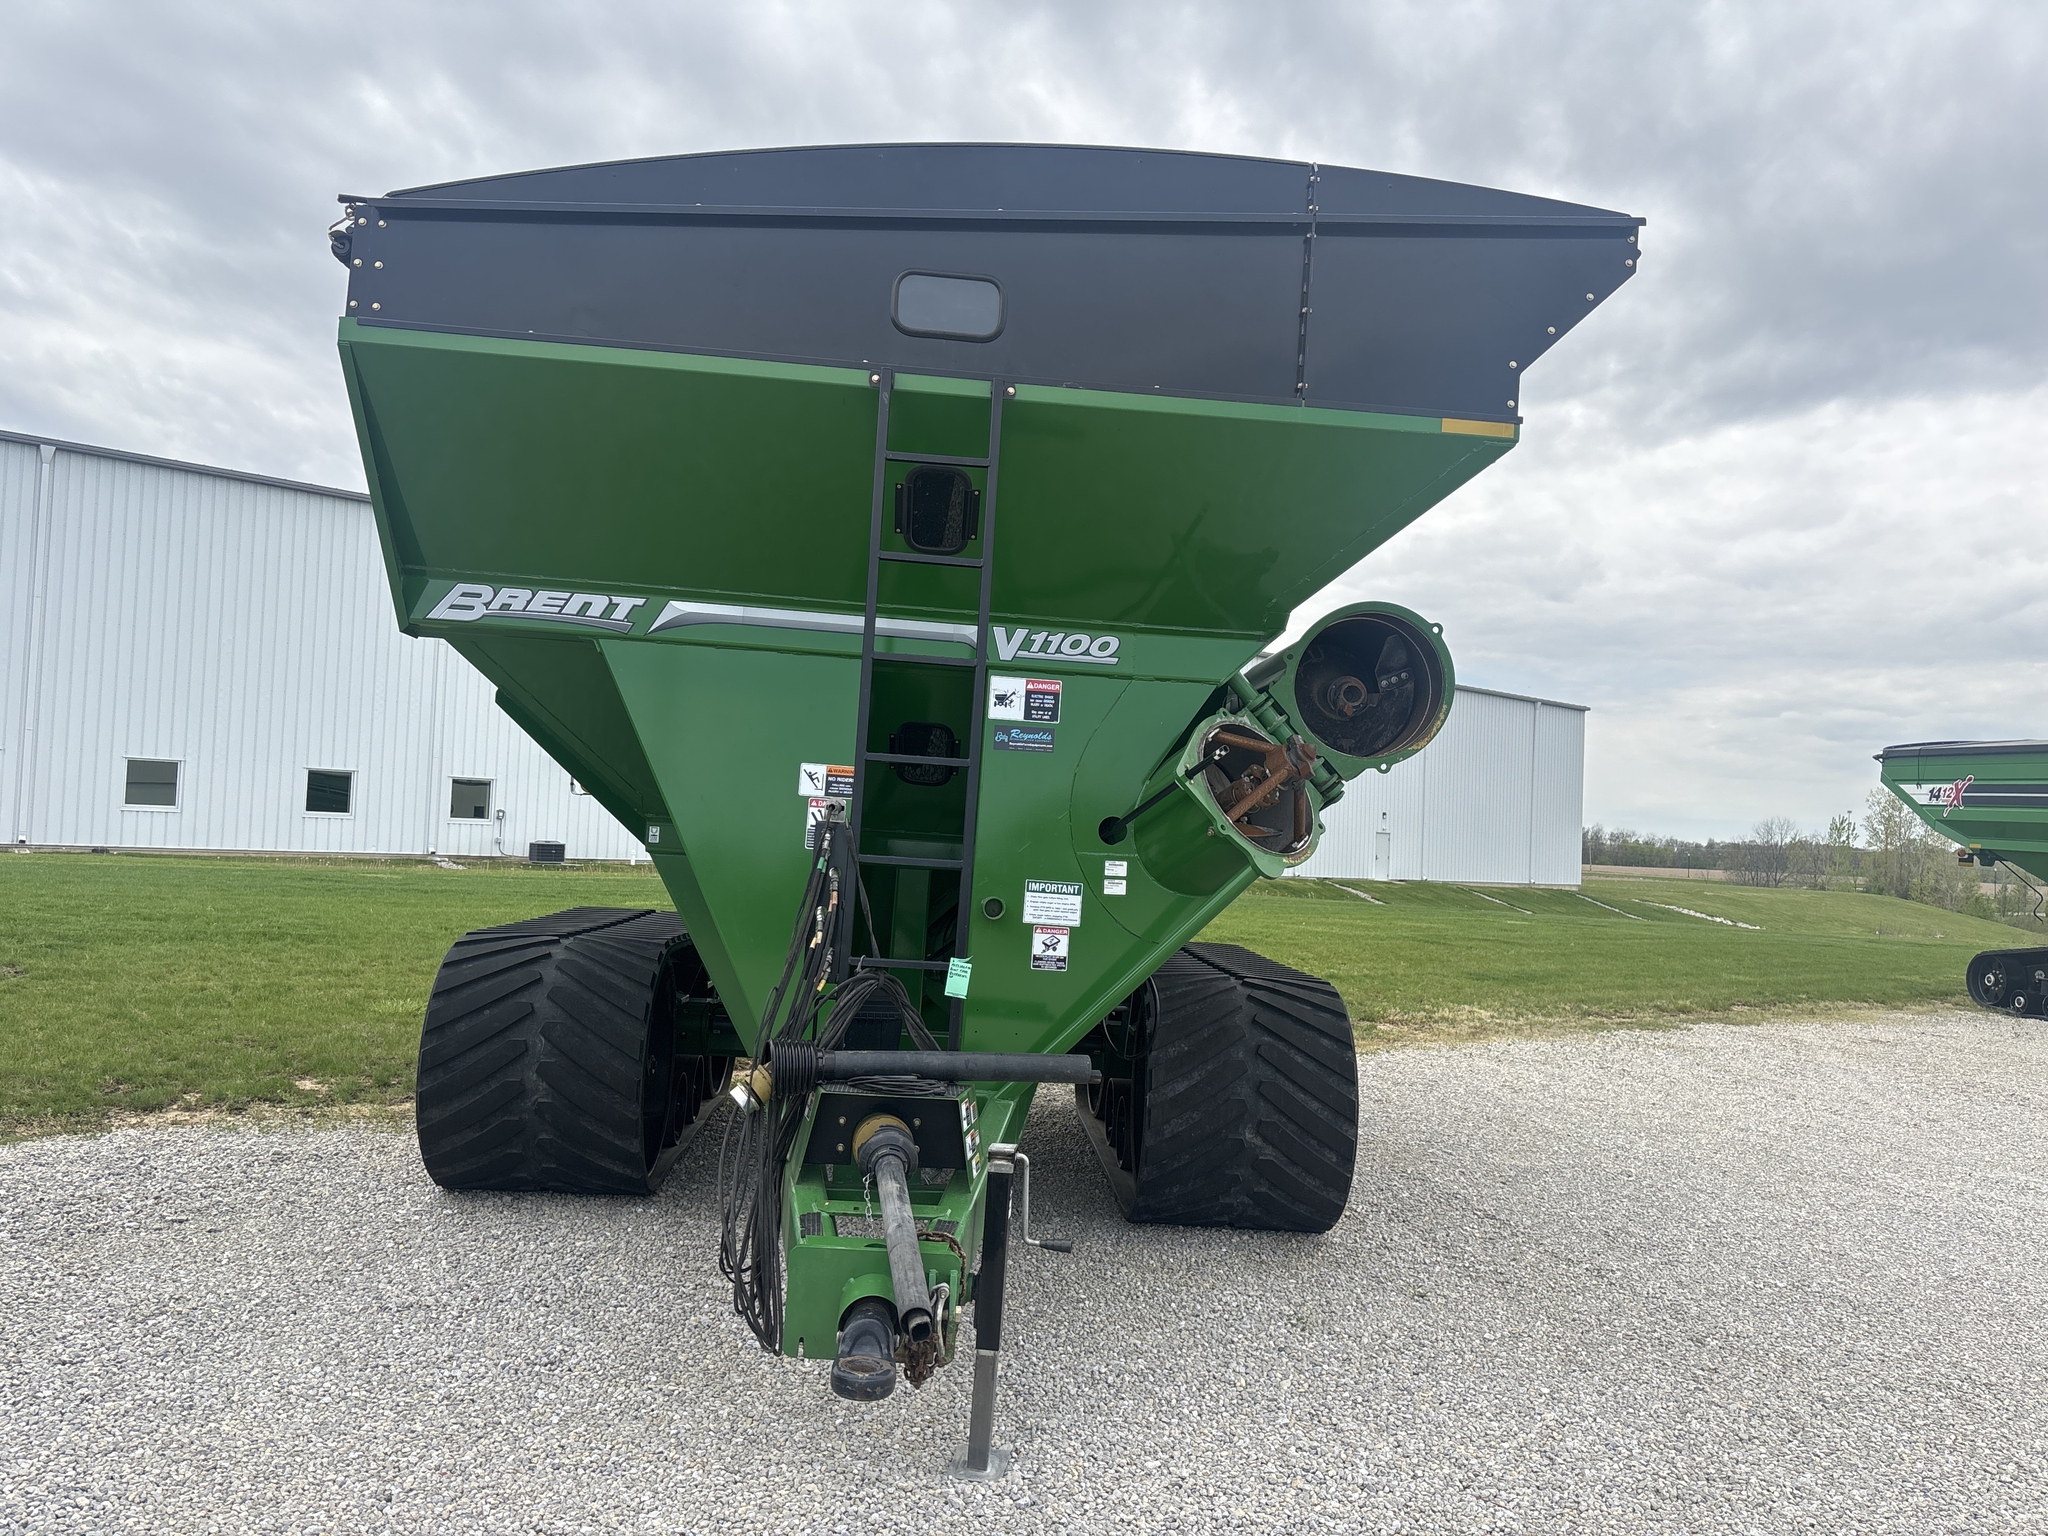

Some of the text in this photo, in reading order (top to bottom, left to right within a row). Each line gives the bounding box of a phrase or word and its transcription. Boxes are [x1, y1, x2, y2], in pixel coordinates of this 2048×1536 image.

[426, 583, 649, 624] BRENT
[992, 626, 1120, 661] V1100
[1010, 729, 1052, 741] Reynolds
[1028, 882, 1079, 894] IMPORTANT
